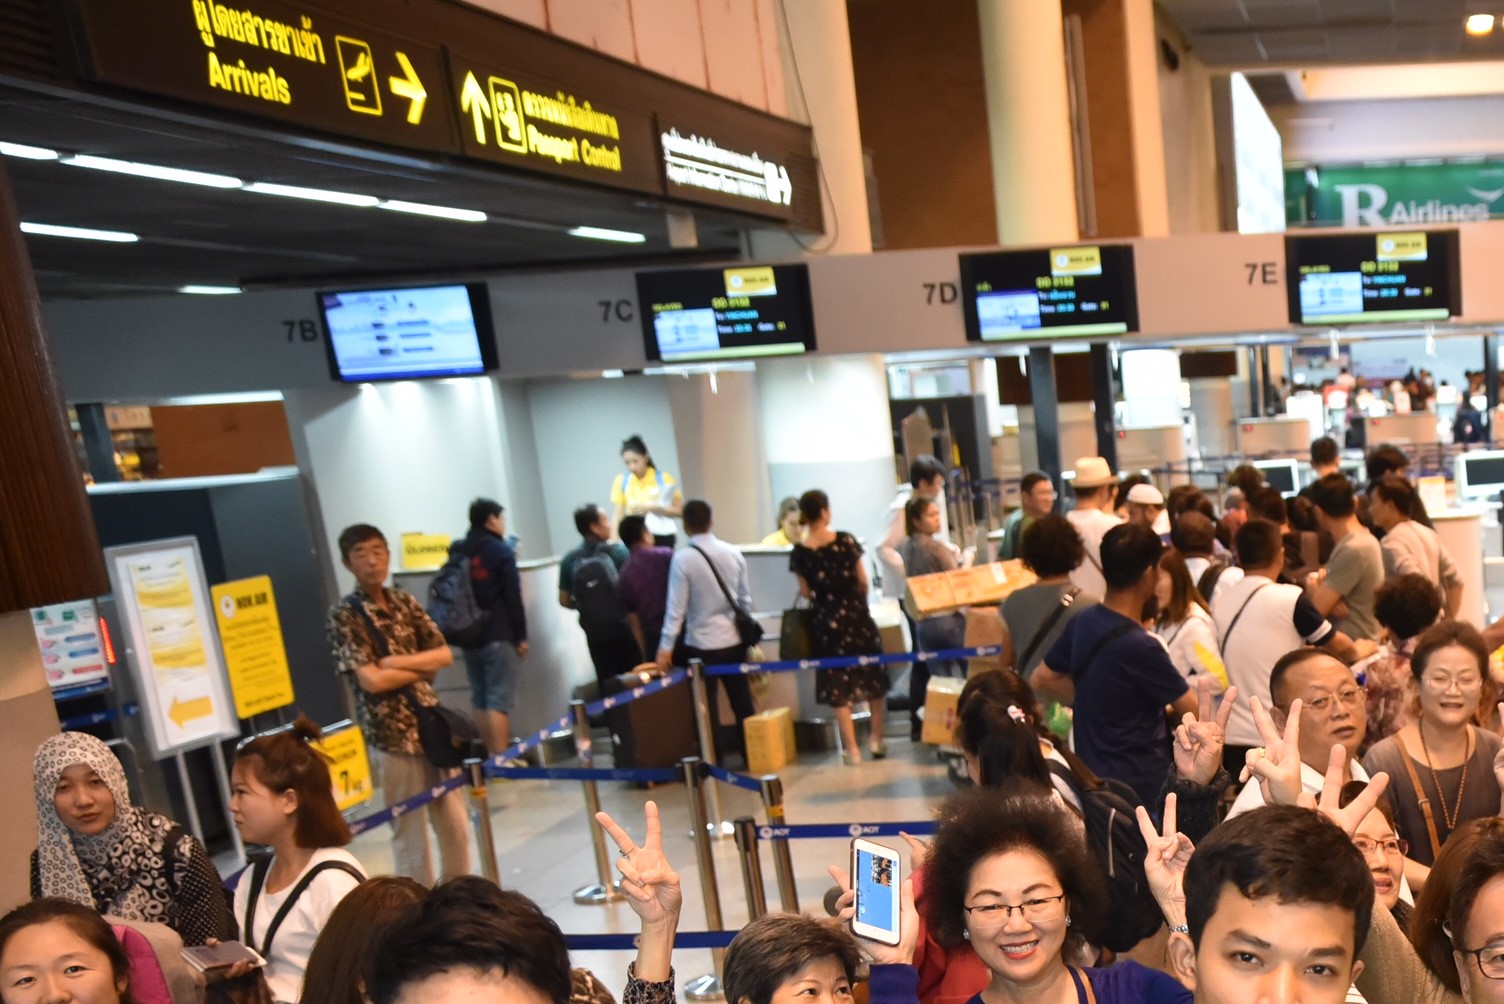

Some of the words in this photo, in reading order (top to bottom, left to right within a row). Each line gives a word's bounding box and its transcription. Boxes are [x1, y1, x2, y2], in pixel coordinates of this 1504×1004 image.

[193, 0, 326, 64] ผูโดยสารขาเข้า
[208, 52, 291, 105] Arrivals
[526, 124, 580, 164] Passport
[581, 137, 623, 171] Control
[1389, 200, 1490, 225] Airlines
[1245, 262, 1278, 285] 7E
[922, 282, 958, 306] 7D
[600, 298, 634, 322] 7C
[281, 319, 319, 342] 7B
